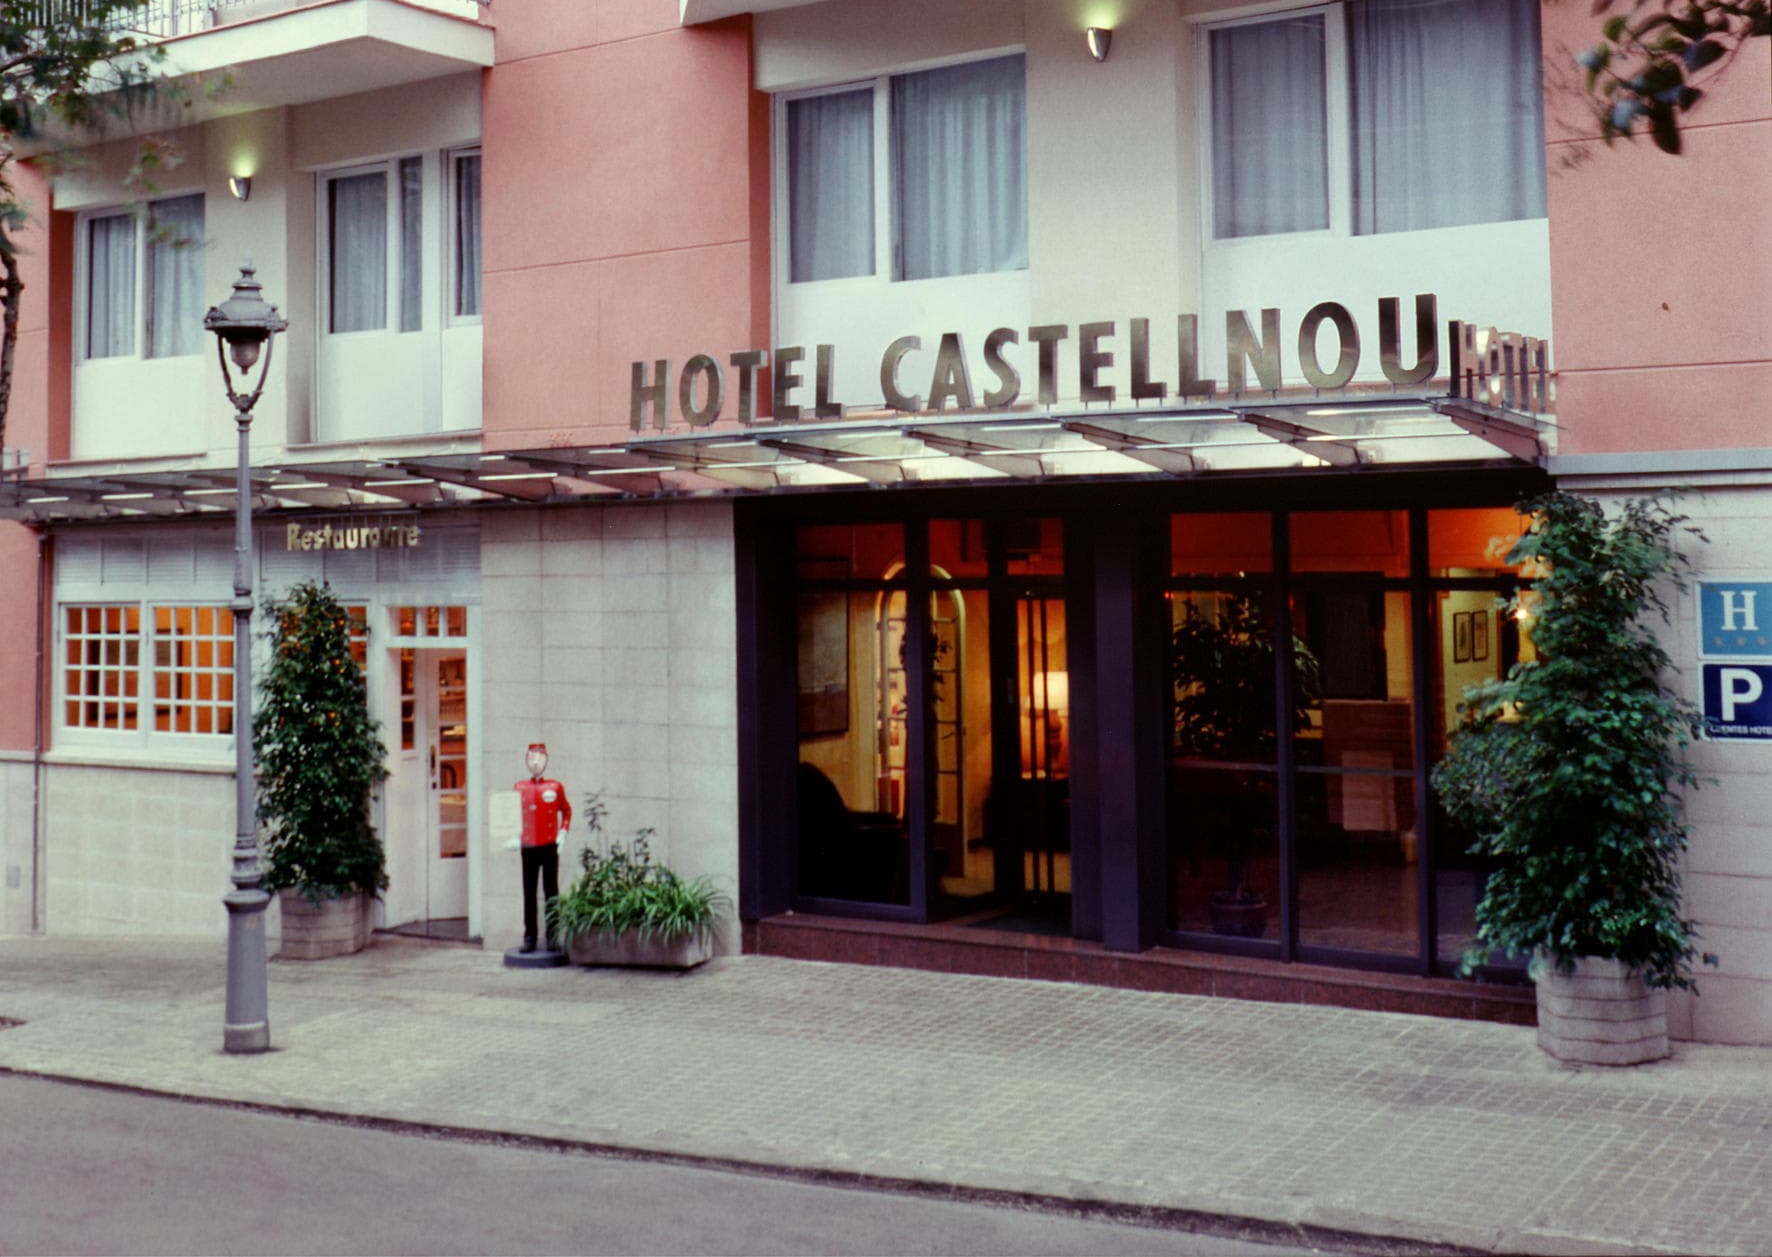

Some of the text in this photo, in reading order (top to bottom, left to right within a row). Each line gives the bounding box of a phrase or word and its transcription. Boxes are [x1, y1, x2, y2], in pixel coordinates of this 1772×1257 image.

[630, 293, 1438, 431] HOTEL CASTELLNOU
[287, 523, 419, 551] Restaurante
[1720, 591, 1759, 631] H
[1720, 668, 1763, 721] P
